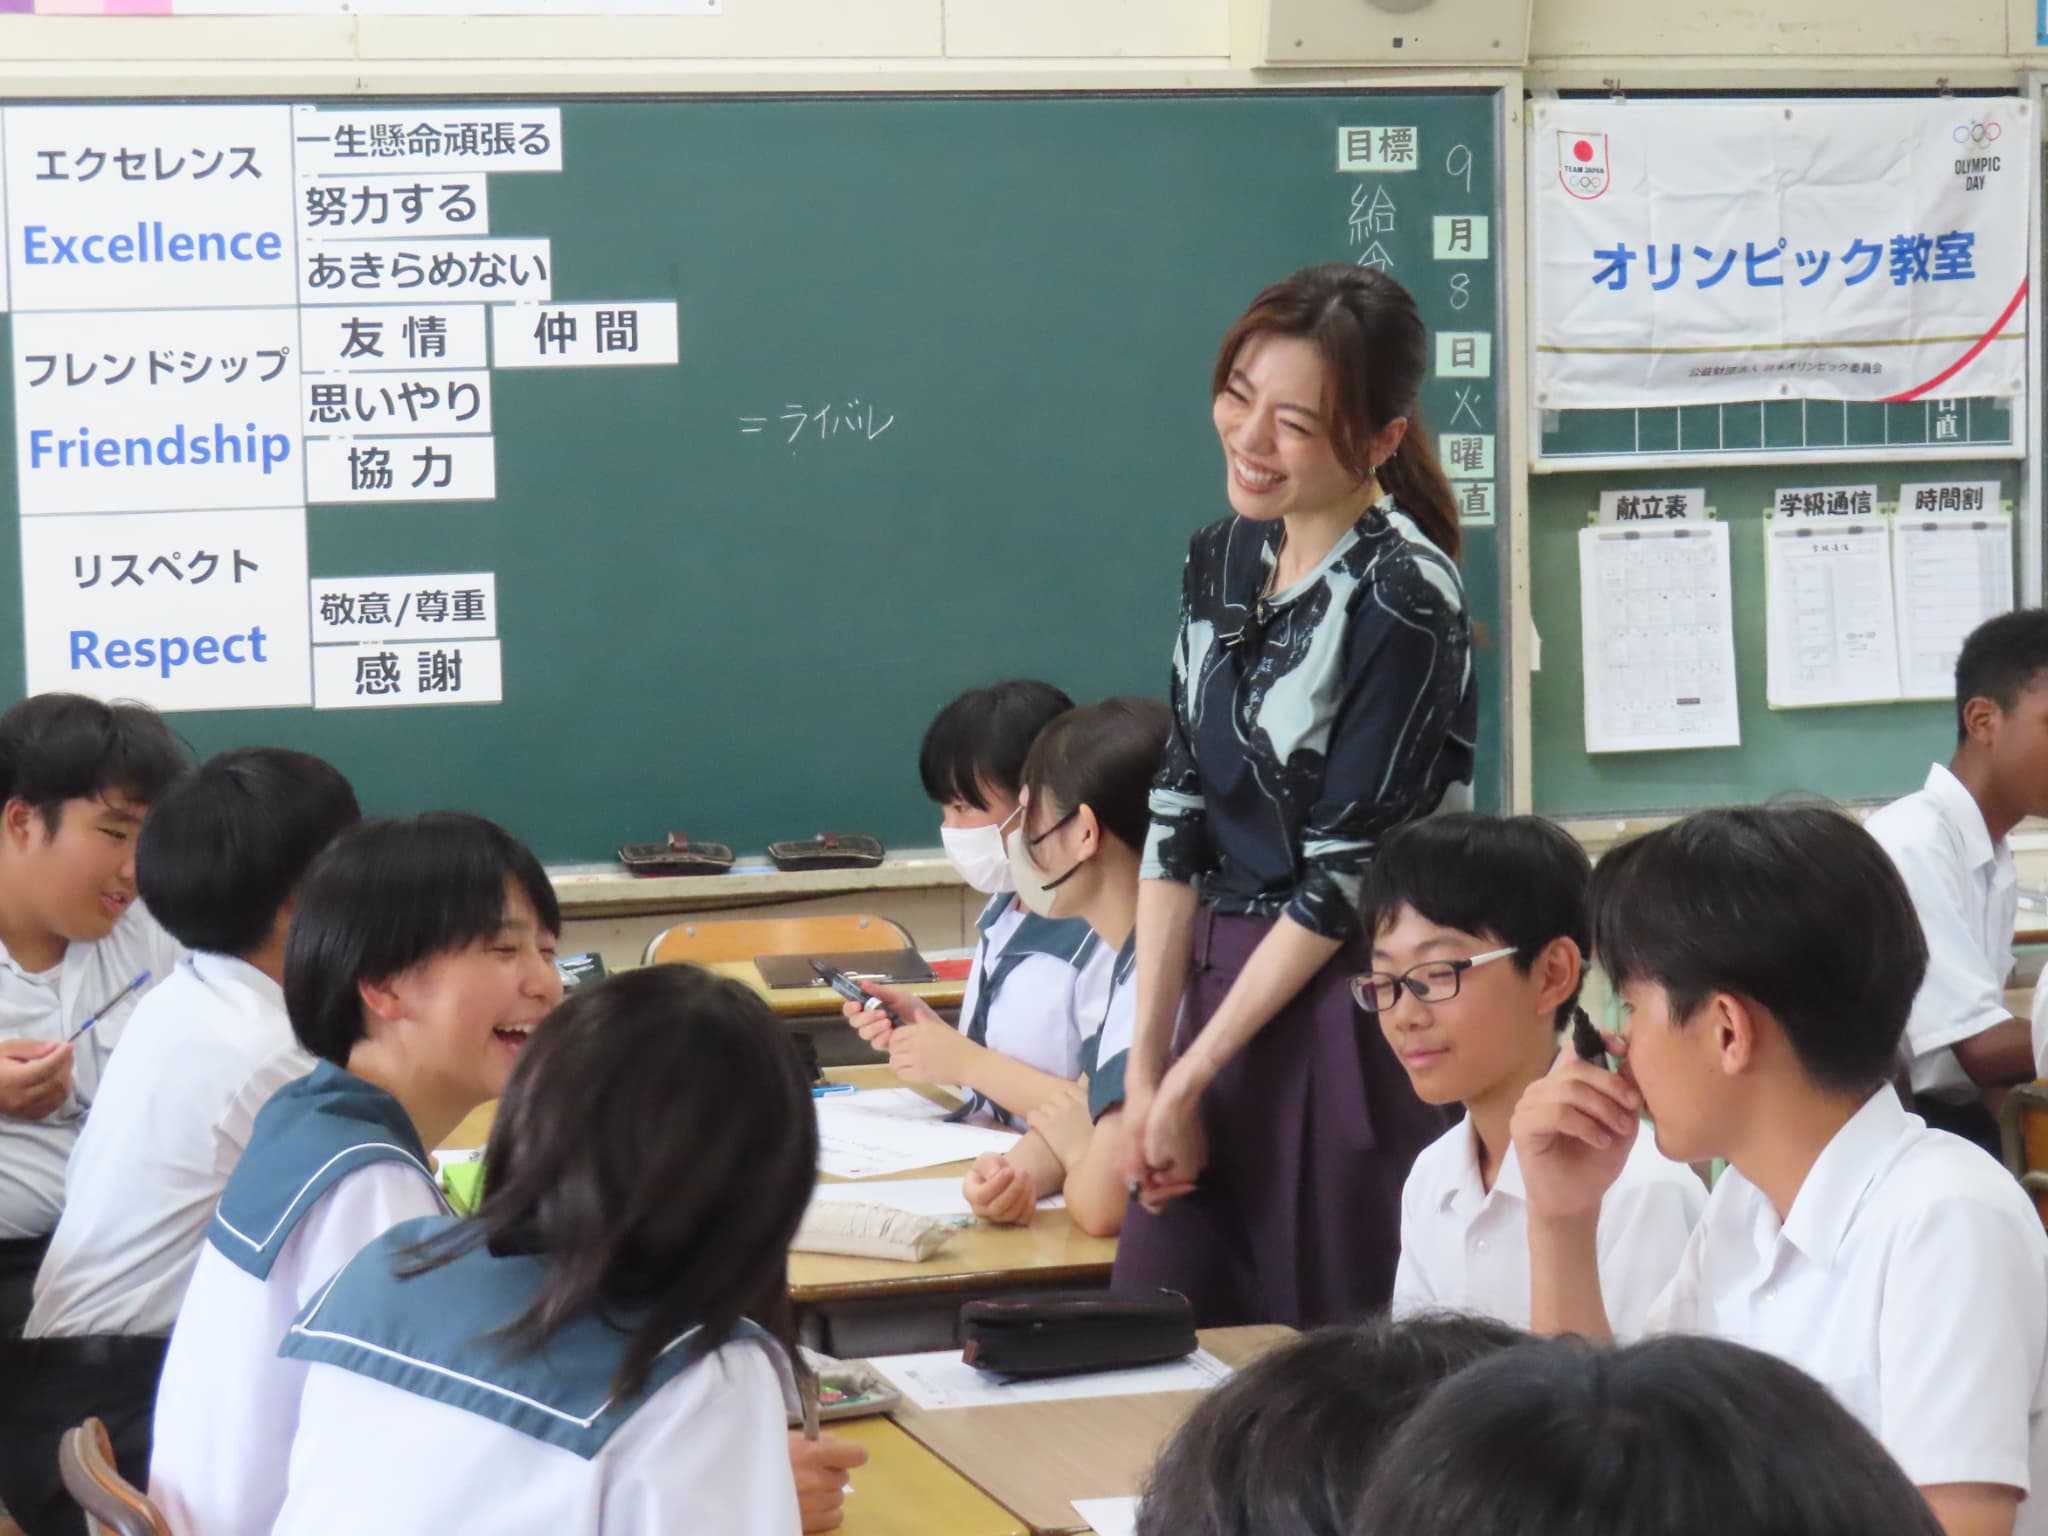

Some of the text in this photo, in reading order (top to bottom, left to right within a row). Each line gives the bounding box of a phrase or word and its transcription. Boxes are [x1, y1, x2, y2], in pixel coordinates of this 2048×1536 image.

[297, 122, 550, 157] 一生懸命頑張る
[1346, 127, 1414, 163] 目標
[36, 147, 262, 182] エクセレンス
[1954, 155, 2001, 175] OLYMPIC
[1966, 175, 1985, 192] DAY
[305, 184, 477, 227] 努力する
[24, 222, 282, 265] Excellence
[1592, 231, 1976, 291] オリンピック教室
[308, 251, 547, 289] あきらめない
[340, 315, 448, 359] 友情
[533, 310, 639, 355] 仲間
[25, 346, 290, 387] フレンドシップ
[309, 381, 482, 423] 思いやり
[30, 424, 290, 474] Friendship
[347, 447, 453, 490] 協力
[1615, 494, 1689, 520] 献立表
[1779, 490, 1872, 518] 学級通信
[1914, 487, 1985, 512] 時間割
[74, 550, 259, 589] リスペクト
[320, 589, 487, 627] 敬意/尊重
[70, 626, 266, 679] Respect
[355, 650, 463, 695] 感謝
